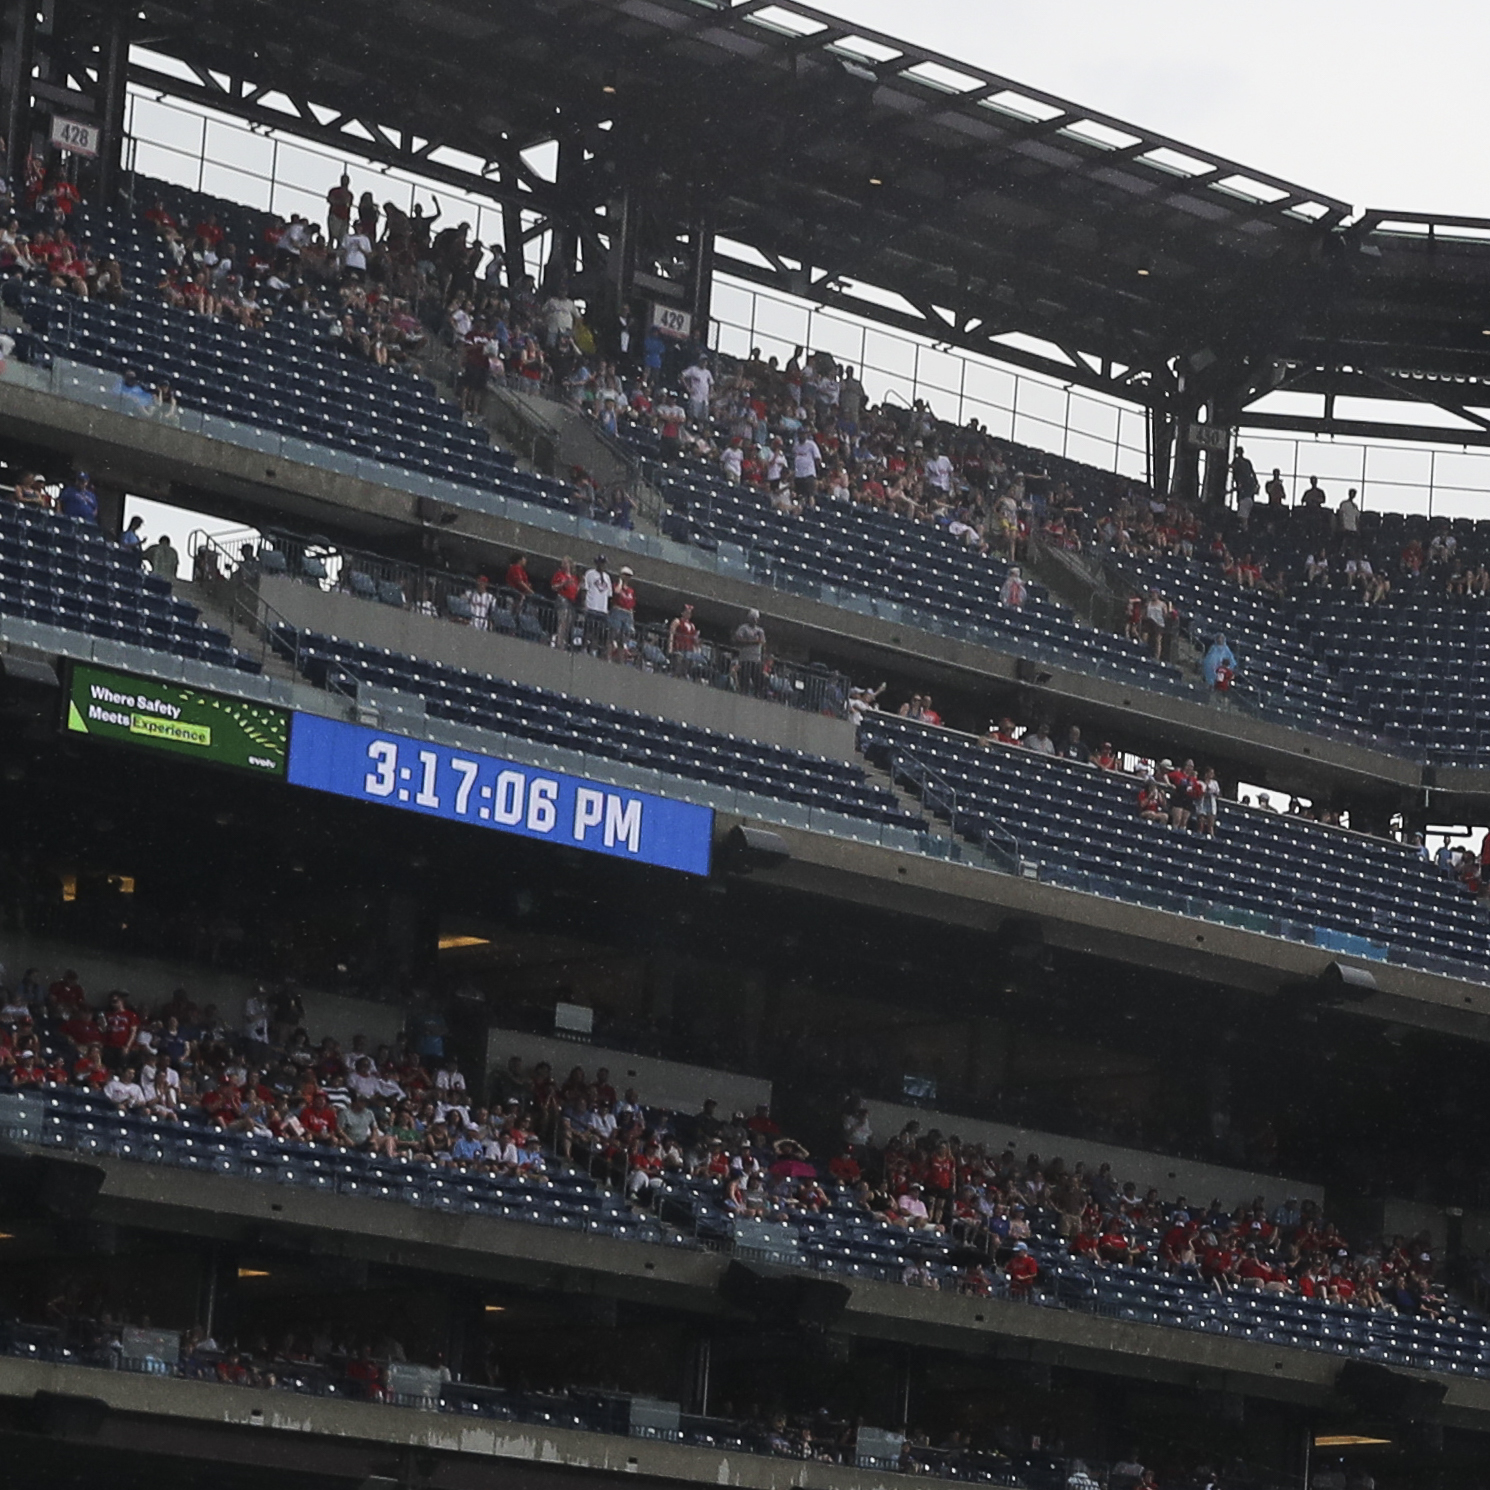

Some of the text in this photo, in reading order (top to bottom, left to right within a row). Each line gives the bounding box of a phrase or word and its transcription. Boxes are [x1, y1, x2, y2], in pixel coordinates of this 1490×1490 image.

[60, 124, 89, 148] 428
[661, 310, 685, 330] 429
[90, 684, 181, 719] Where Safety
[88, 704, 207, 743] Meets Experience
[365, 739, 643, 853] 3:17:06 PM
